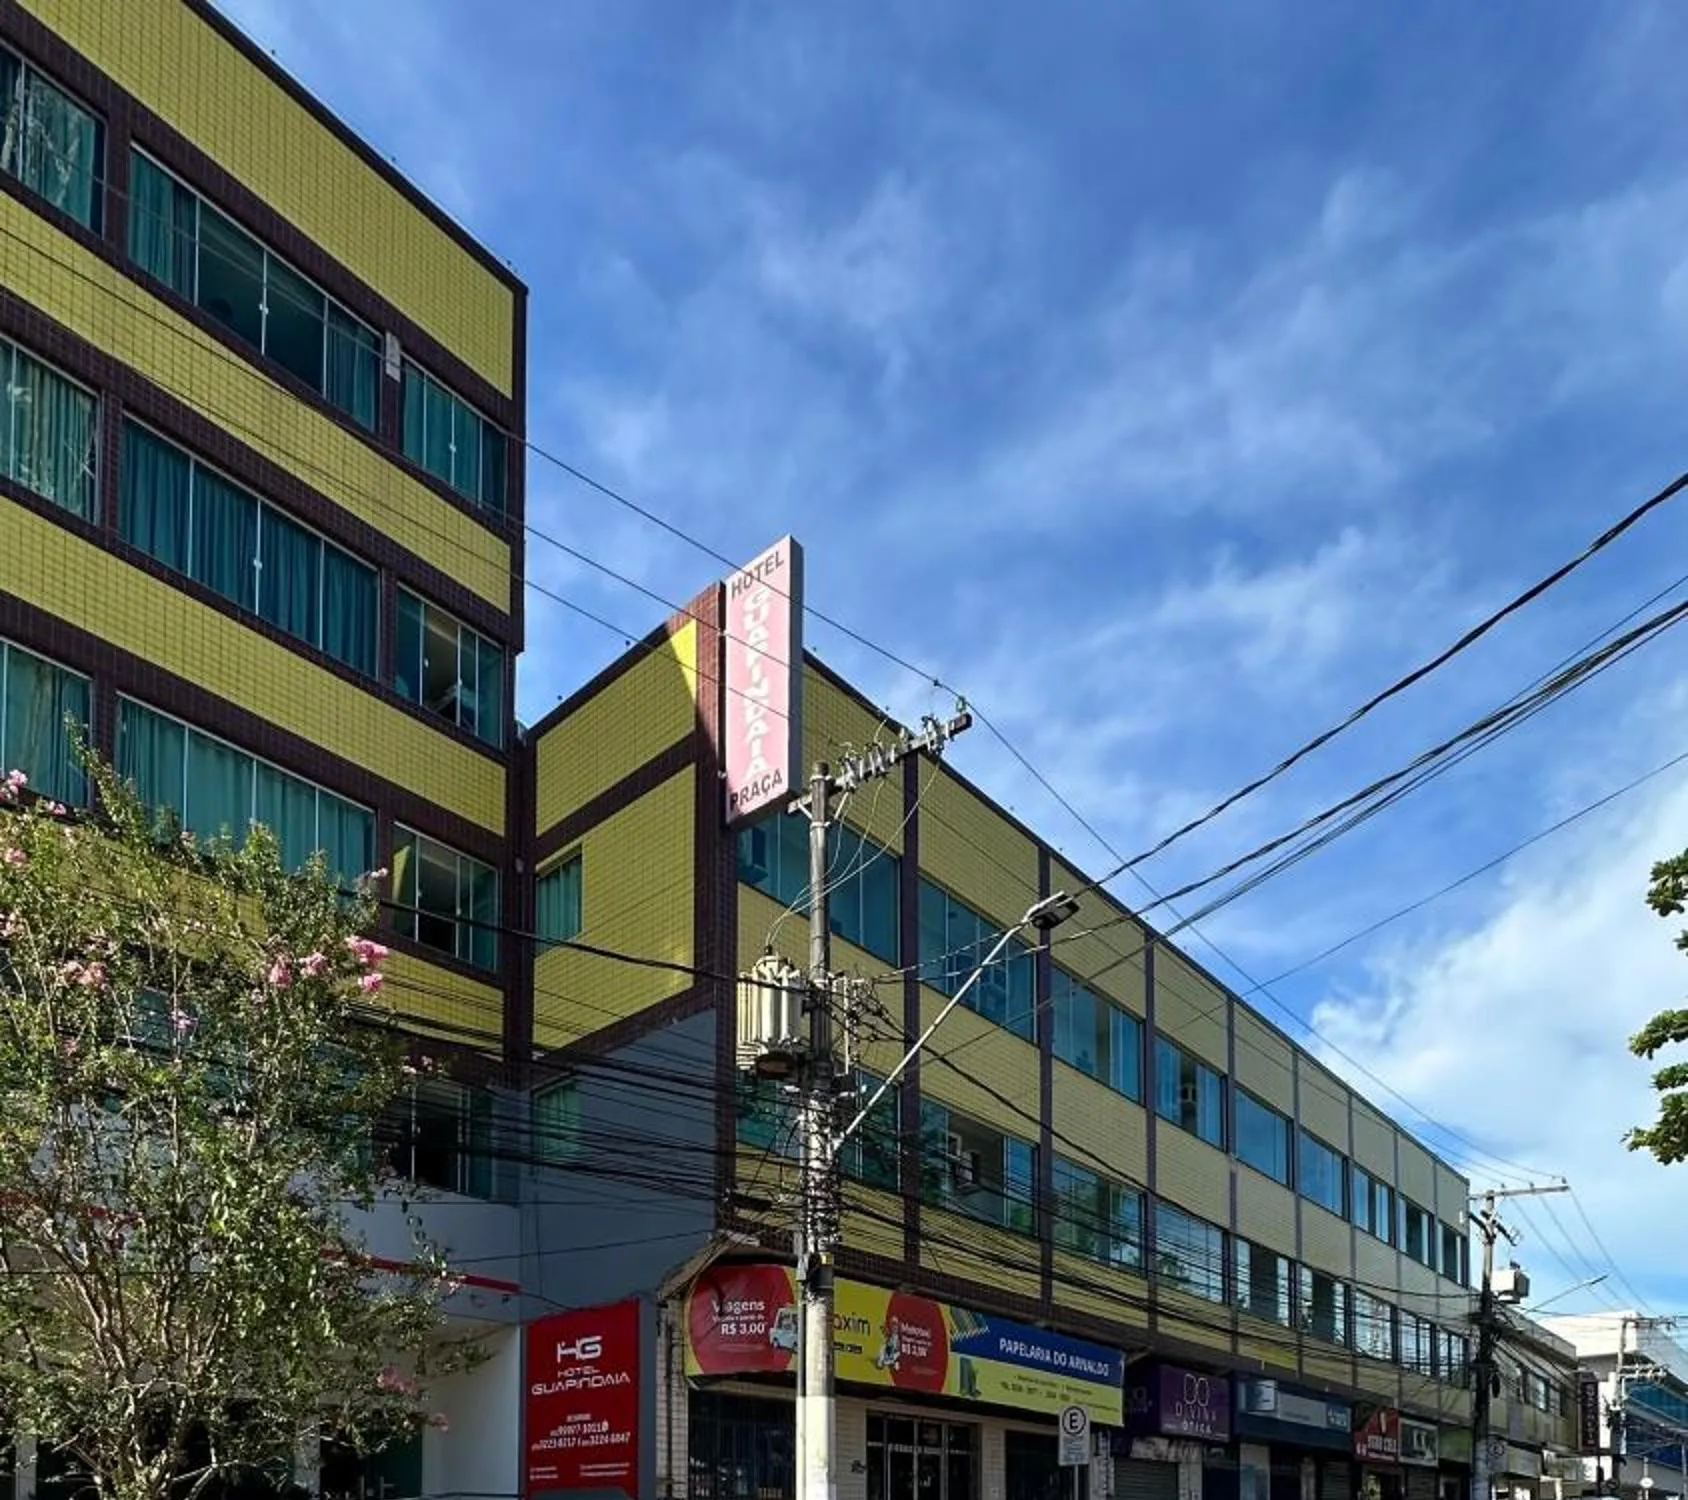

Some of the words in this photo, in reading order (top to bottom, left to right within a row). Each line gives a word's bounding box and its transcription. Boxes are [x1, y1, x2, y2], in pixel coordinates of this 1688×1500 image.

[731, 551, 785, 599] HOTEL
[730, 770, 782, 811] PRAÇA
[712, 1301, 766, 1314] Vagens
[832, 1311, 871, 1336] axim
[999, 1337, 1052, 1363] PAPELARIA
[1053, 1351, 1067, 1367] DO
[531, 1371, 631, 1395] GUAPINDAIA
[557, 1364, 601, 1378] HOTEL
[1069, 1411, 1079, 1430] E
